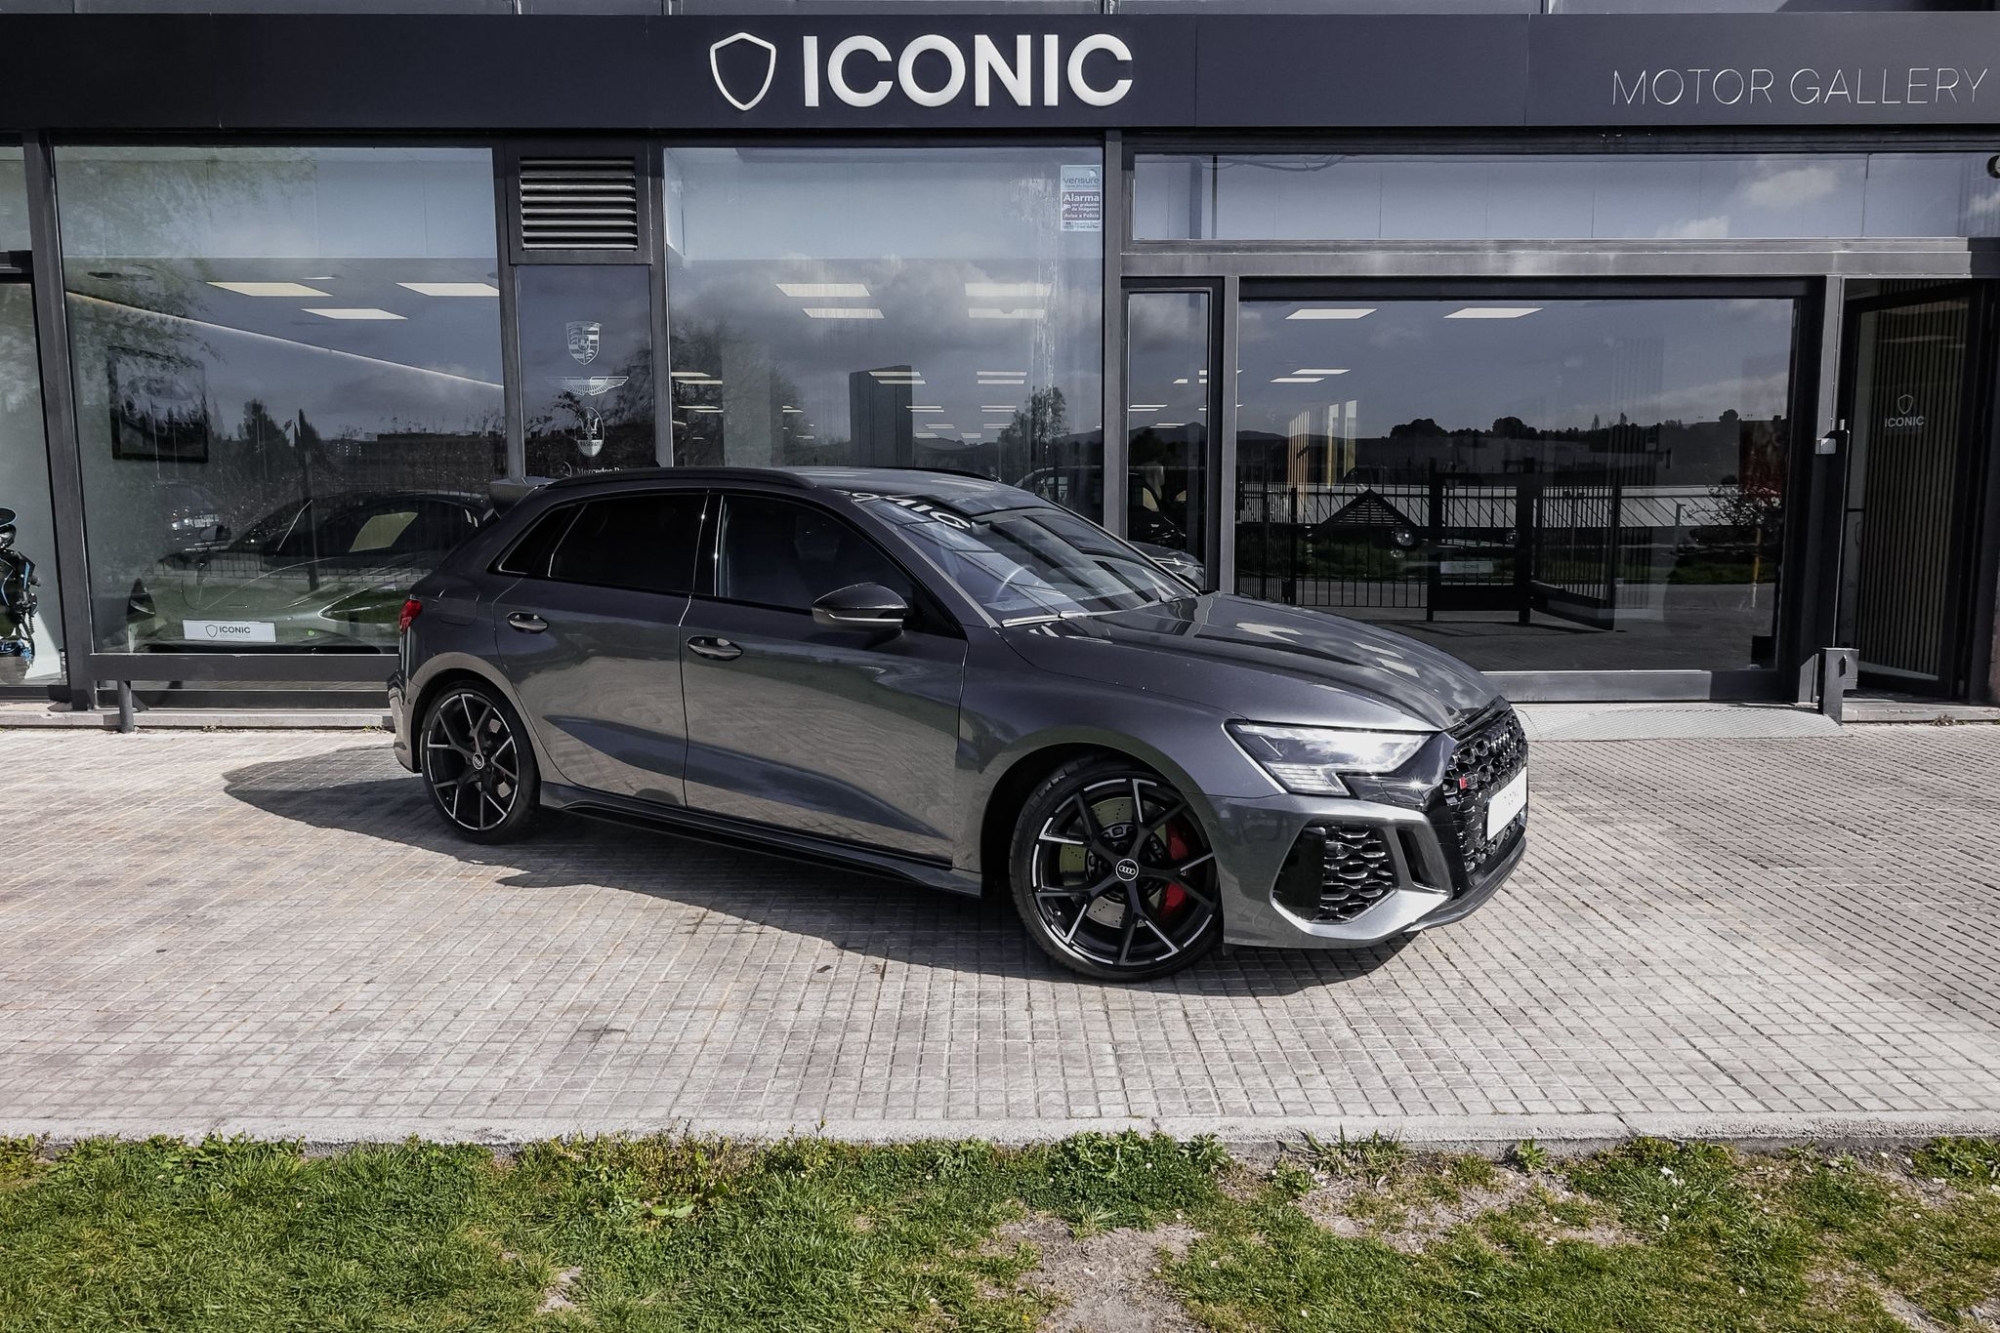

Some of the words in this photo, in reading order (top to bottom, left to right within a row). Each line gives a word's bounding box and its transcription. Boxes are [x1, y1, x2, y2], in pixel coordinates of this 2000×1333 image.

[803, 33, 1133, 107] ICONIC
[1612, 68, 1774, 105] MOTOR
[1790, 68, 1988, 105] GALLERY
[1063, 193, 1100, 202] Alarma
[1884, 415, 1924, 428] ICONIC
[219, 626, 251, 634] ICONIC
